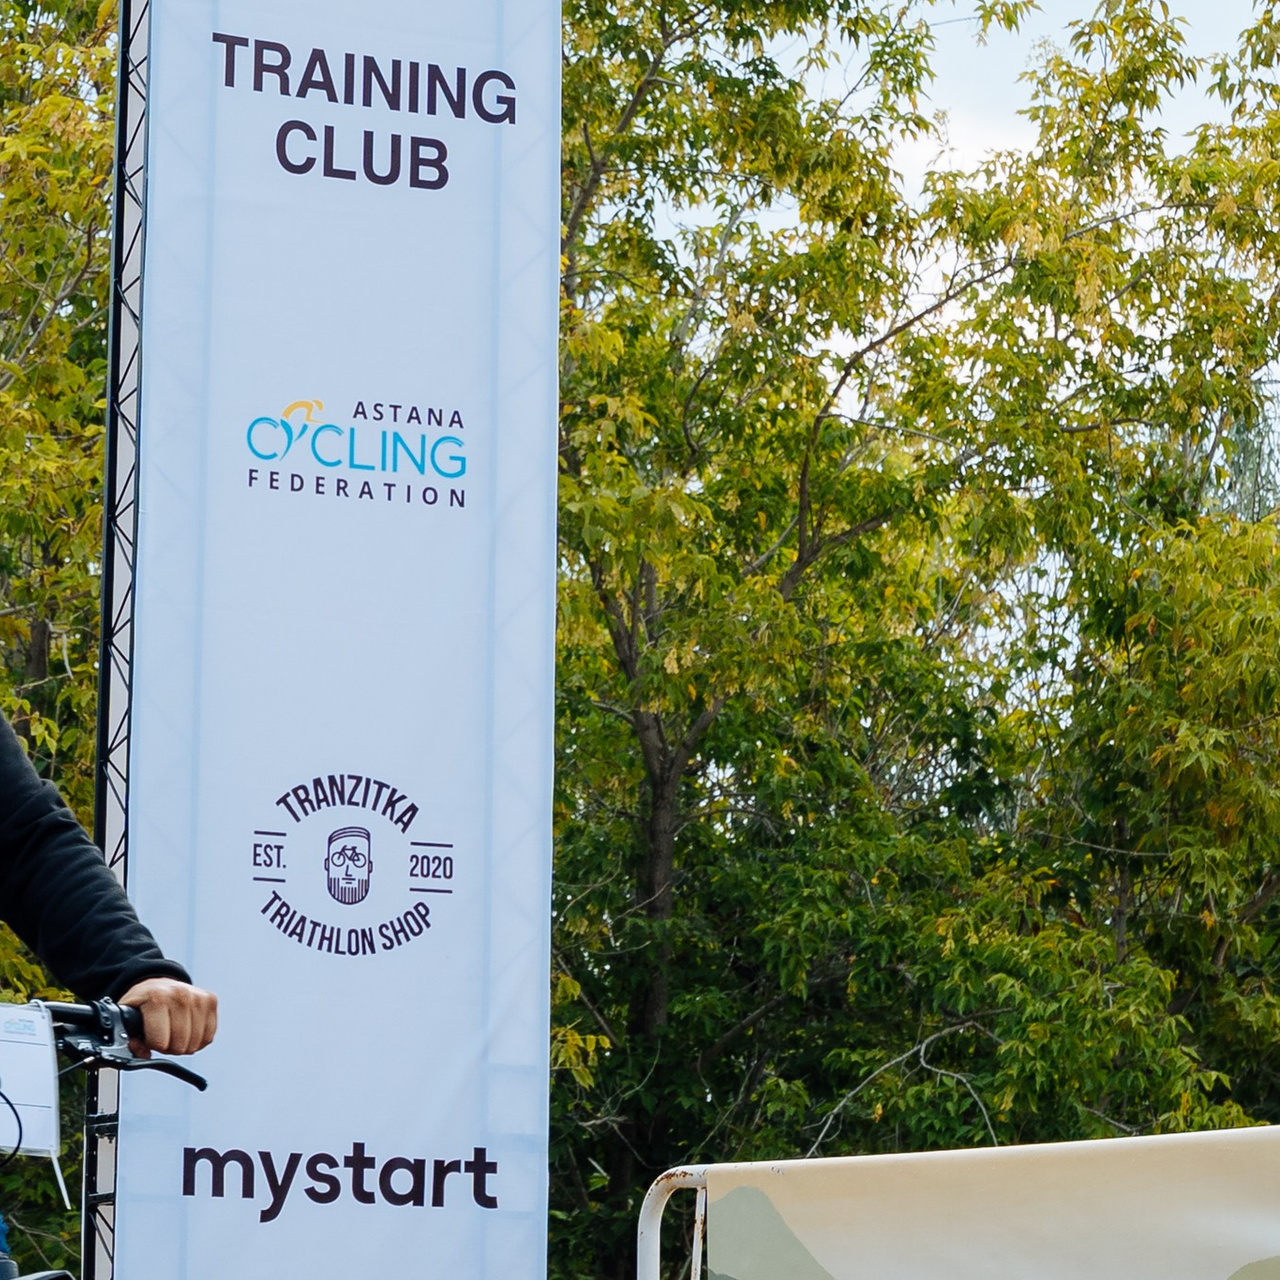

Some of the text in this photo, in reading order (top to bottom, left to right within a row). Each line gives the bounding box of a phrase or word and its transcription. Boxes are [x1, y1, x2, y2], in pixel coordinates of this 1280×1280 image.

[212, 32, 516, 125] TRAINING
[275, 120, 449, 191] CLUB
[352, 401, 464, 429] ASTANA
[246, 416, 467, 478] CYCLING
[248, 468, 466, 508] FEDERATION
[275, 774, 420, 835] TRANZITKA
[252, 843, 454, 880] EST. 2020
[260, 890, 432, 956] TRIATHLON SHOP
[182, 1141, 498, 1223] mystart
